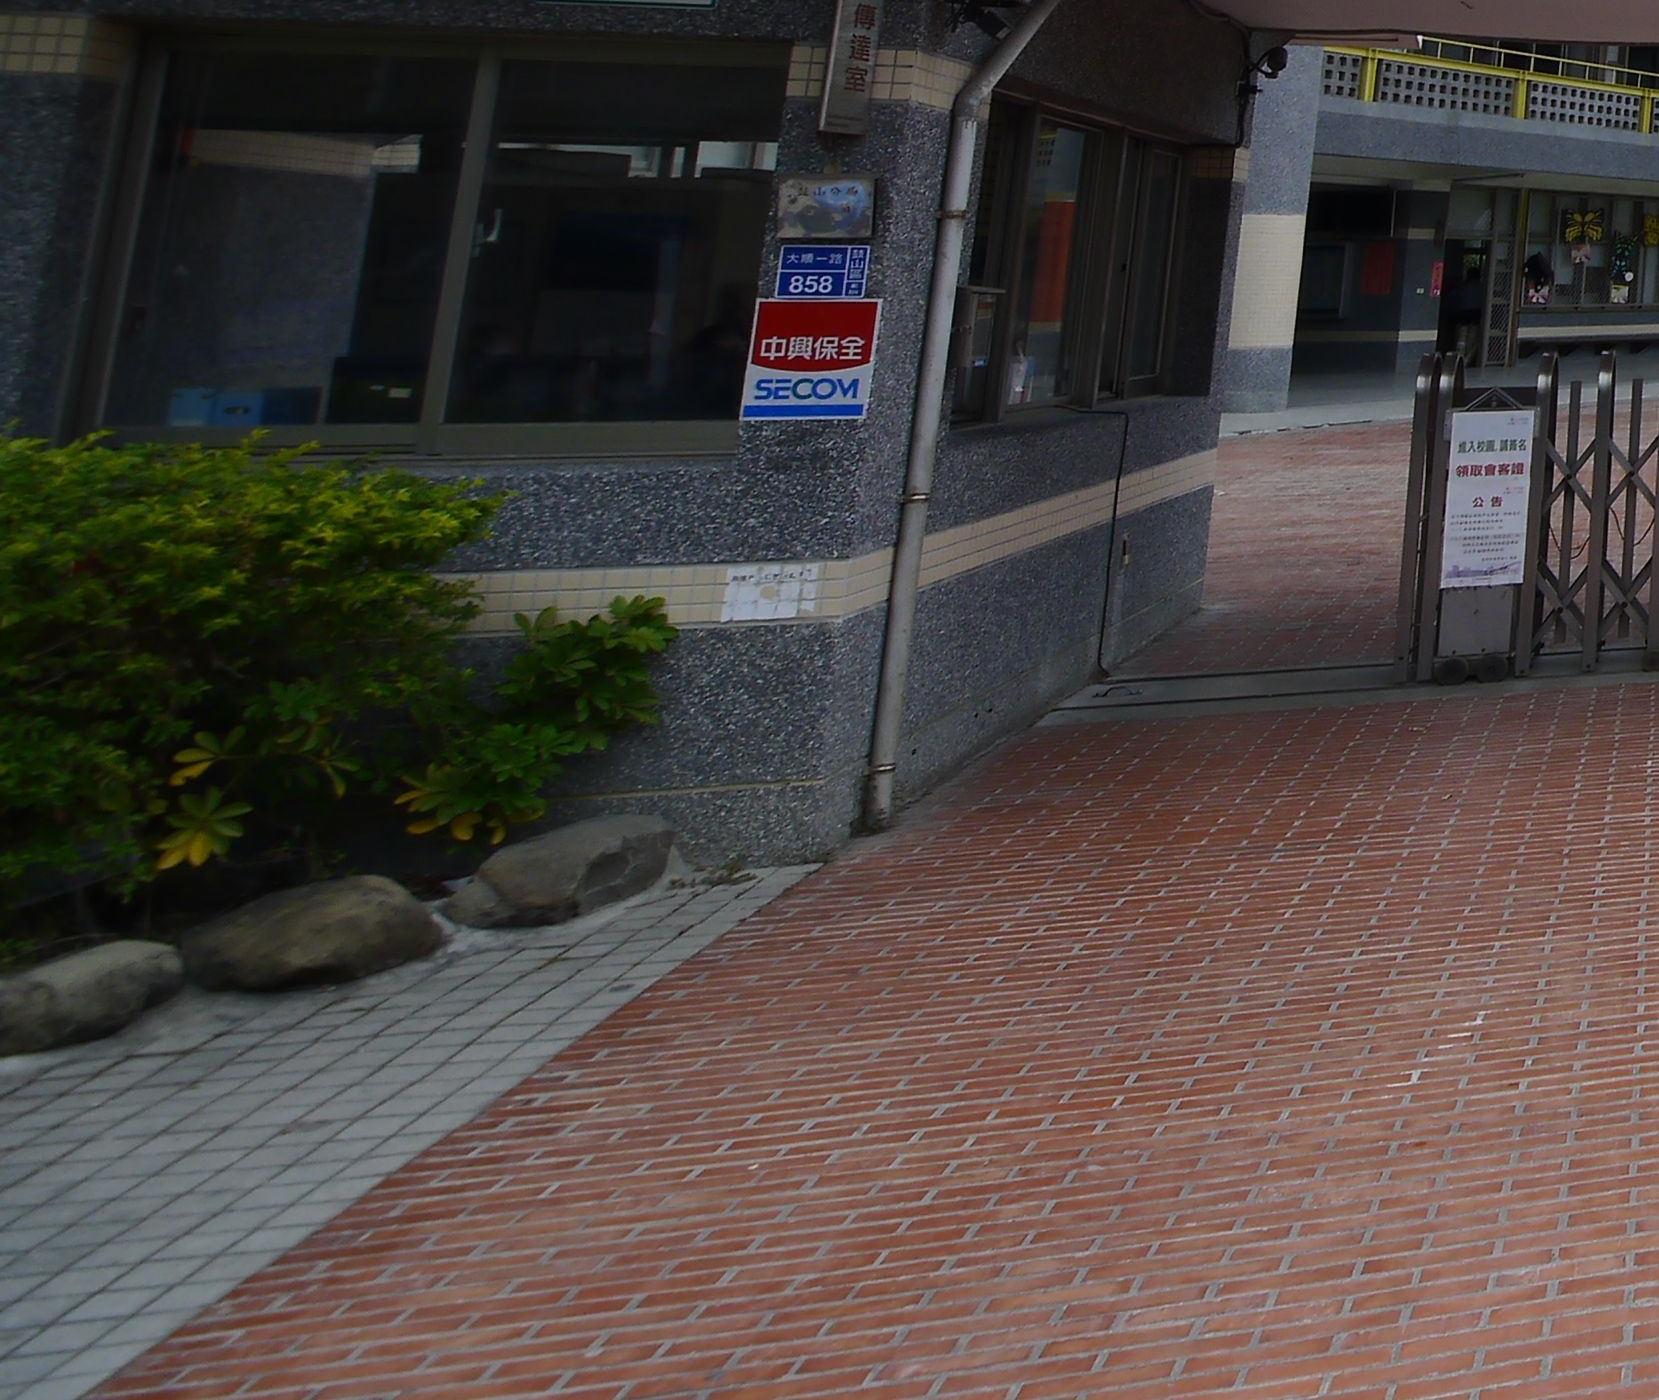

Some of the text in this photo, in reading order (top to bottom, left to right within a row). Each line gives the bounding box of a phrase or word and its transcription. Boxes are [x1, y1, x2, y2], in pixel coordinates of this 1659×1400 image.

[844, 2, 878, 93] 傳達室
[786, 252, 844, 265] 大順一路
[788, 275, 833, 294] 858
[760, 335, 865, 361] 中興保全
[753, 377, 860, 401] SECOM
[1455, 461, 1524, 478] 領取會客證
[1472, 495, 1504, 508] 公告
